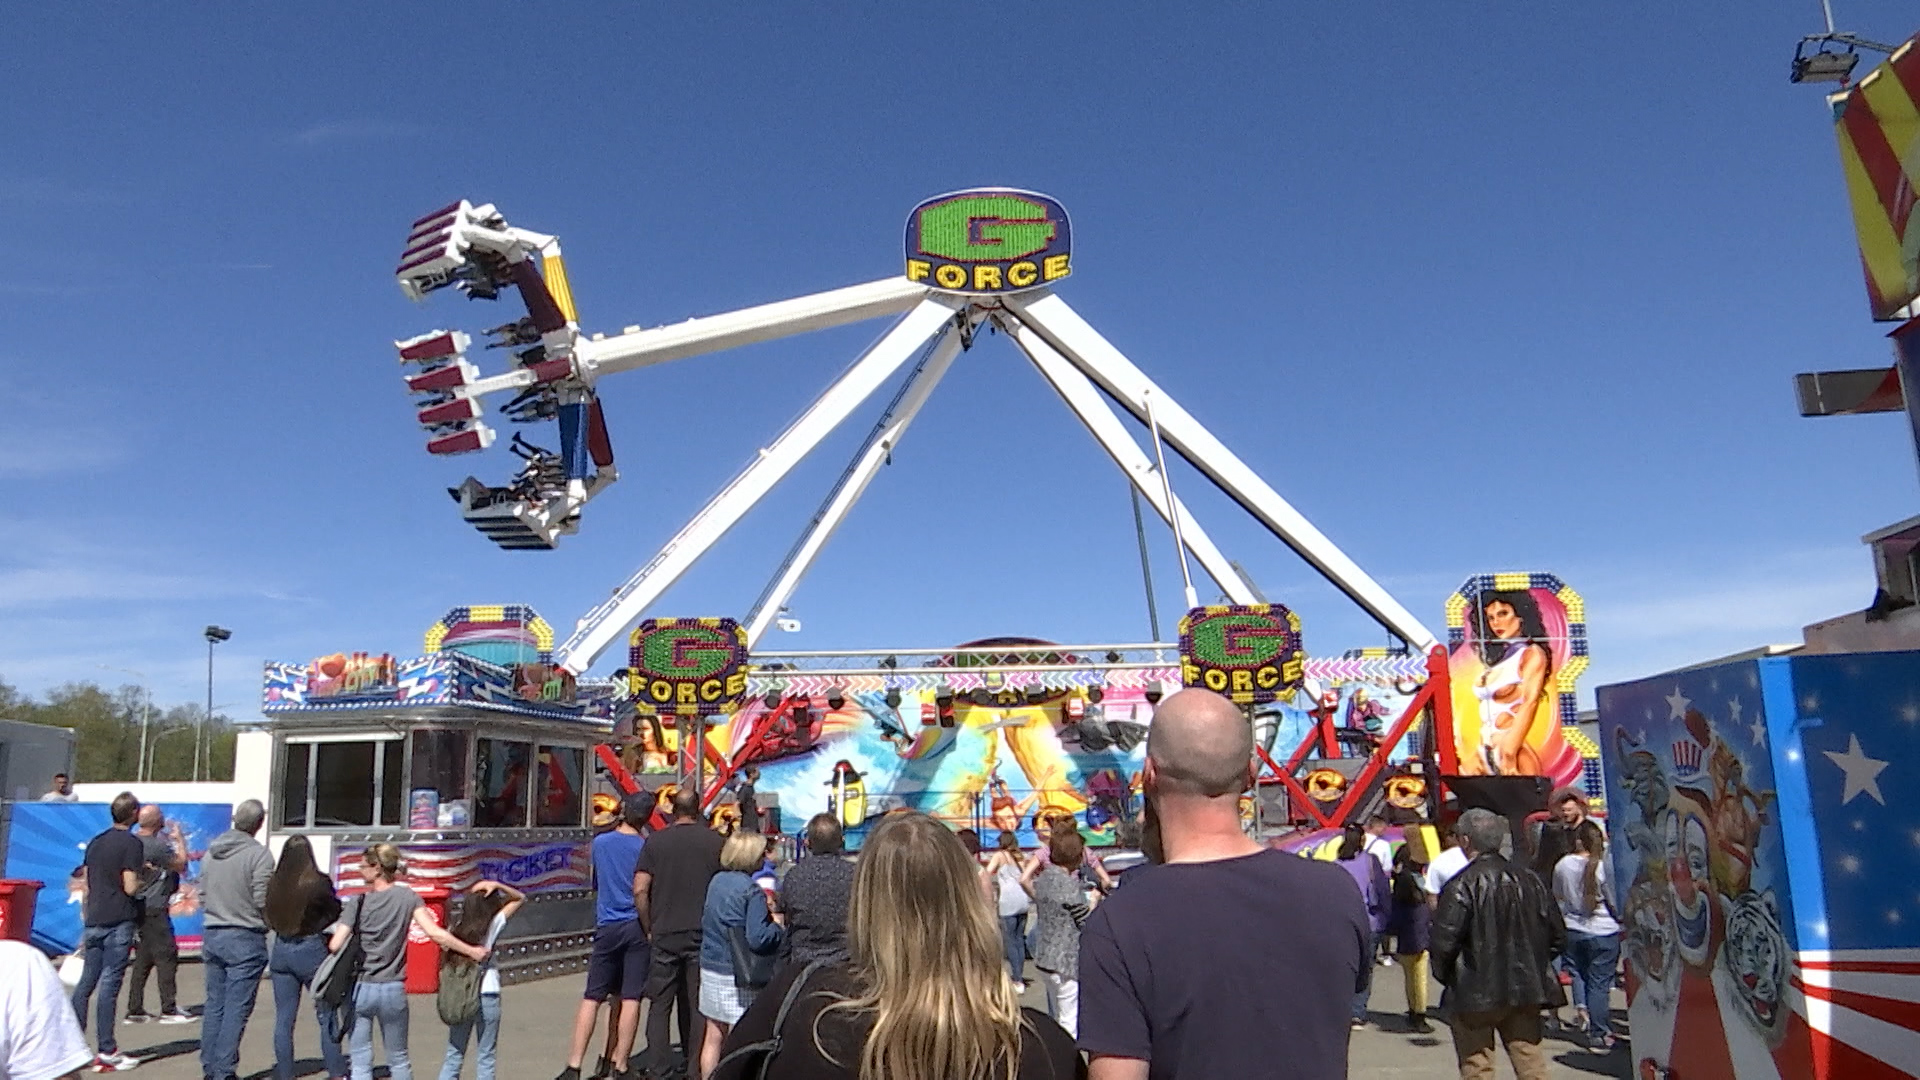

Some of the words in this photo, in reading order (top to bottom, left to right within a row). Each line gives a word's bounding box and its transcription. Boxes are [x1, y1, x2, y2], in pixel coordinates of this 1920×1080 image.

[918, 194, 1056, 262] G
[907, 255, 1071, 290] FORCE
[640, 625, 735, 680] G
[1190, 612, 1288, 669] G
[630, 673, 747, 704] FORCE
[1183, 660, 1302, 691] FORCE
[479, 847, 573, 881] TICKET
